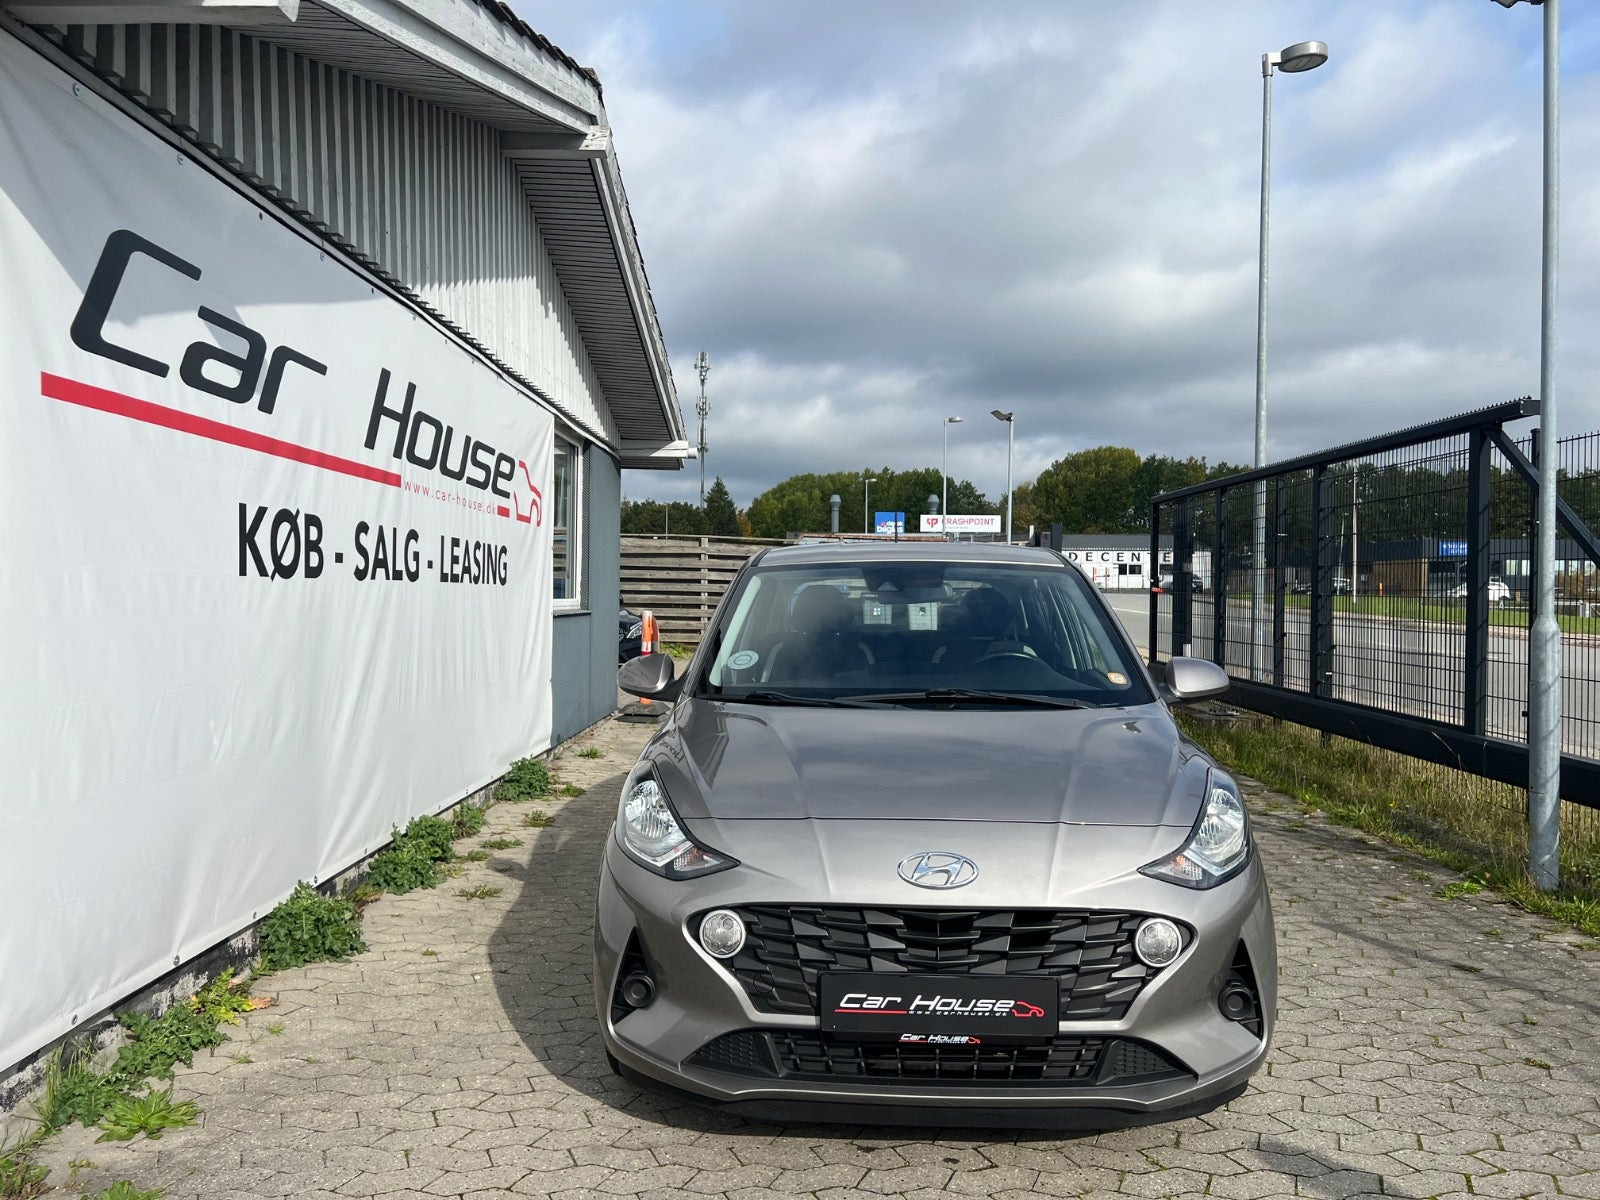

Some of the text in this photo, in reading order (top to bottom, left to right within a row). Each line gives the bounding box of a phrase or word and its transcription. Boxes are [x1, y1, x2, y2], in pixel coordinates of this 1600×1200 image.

[71, 229, 515, 498] Car House
[404, 480, 496, 515] www.car-house.dk
[238, 503, 324, 581] KØB
[353, 521, 420, 582] SALG
[439, 535, 508, 585] LEASING
[840, 994, 1014, 1011] Car House
[900, 1033, 969, 1042] Car House
